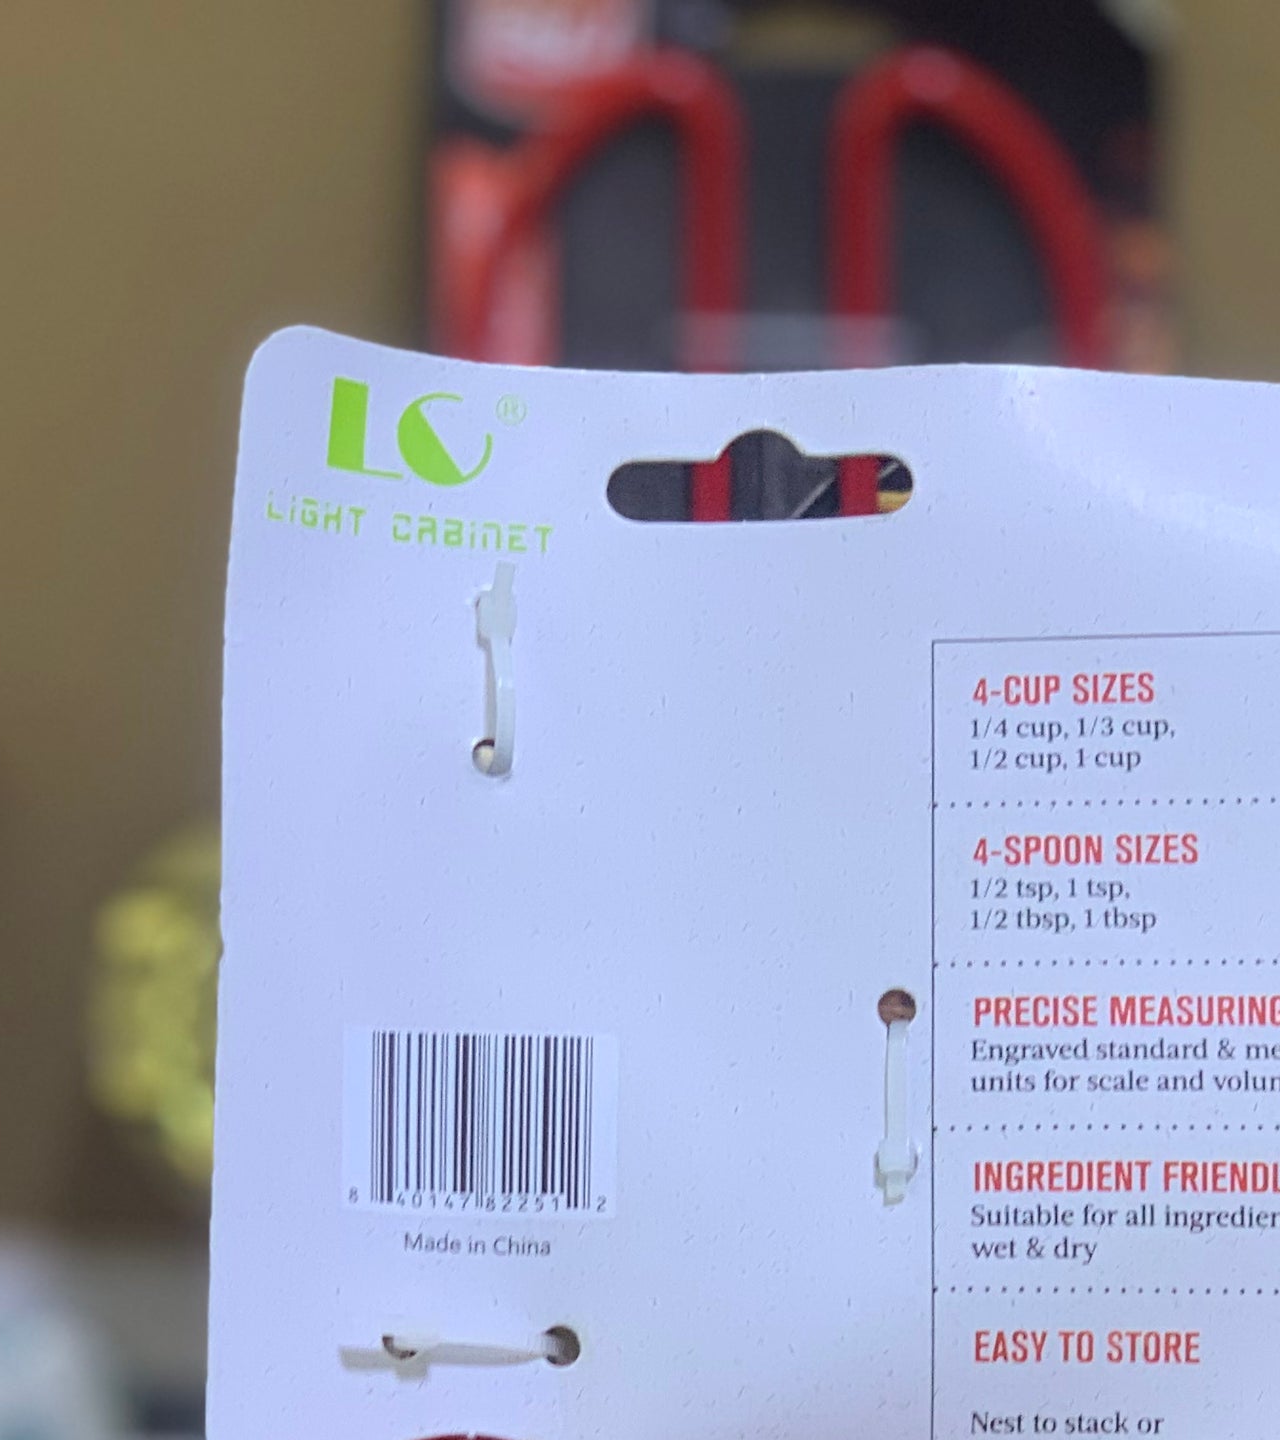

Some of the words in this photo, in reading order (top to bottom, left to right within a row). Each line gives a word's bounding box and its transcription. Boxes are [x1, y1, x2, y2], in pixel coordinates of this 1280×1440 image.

[972, 674, 1061, 707] 4-CUP
[1072, 672, 1155, 705] SIZES
[971, 718, 1008, 739] 1/4
[1016, 721, 1069, 743] cup,
[1078, 716, 1114, 737] 1/3
[1121, 720, 1175, 741] cup,
[972, 749, 1008, 770] 1/2
[1015, 752, 1068, 774] cup,
[1094, 751, 1142, 773] cup
[972, 834, 1103, 867] 4-SPOON
[1115, 833, 1199, 865] SIZES
[972, 878, 1008, 899] 1/2
[1016, 879, 1060, 903] tsp,
[1087, 879, 1130, 903] tsp,
[971, 909, 1008, 930] 1/2
[1016, 907, 1076, 934] tbsp,
[1103, 906, 1157, 934] tbsp
[974, 995, 1098, 1028] PRECISE
[971, 1038, 1088, 1066] Engraved
[1096, 1037, 1208, 1060] standard
[1217, 1039, 1236, 1060] &
[971, 1071, 1036, 1092] units
[1044, 1069, 1080, 1092] for
[1087, 1069, 1149, 1092] scale
[1157, 1069, 1204, 1091] and
[974, 1160, 1152, 1193] INGREDIENT
[971, 1204, 1074, 1227] Suitable
[1083, 1204, 1118, 1226] for
[1125, 1203, 1155, 1227] all
[404, 1231, 462, 1253] Made
[468, 1236, 486, 1255] in
[493, 1235, 551, 1256] China
[971, 1240, 1015, 1259] wet
[1026, 1237, 1045, 1259] &
[1053, 1236, 1097, 1265] dry
[974, 1330, 1048, 1364] EASY
[1058, 1330, 1094, 1364] TO
[1106, 1330, 1201, 1364] STORE
[970, 1411, 1023, 1434] Nest
[1033, 1415, 1057, 1433] to
[1064, 1411, 1128, 1434] stack
[1137, 1418, 1165, 1434] or
